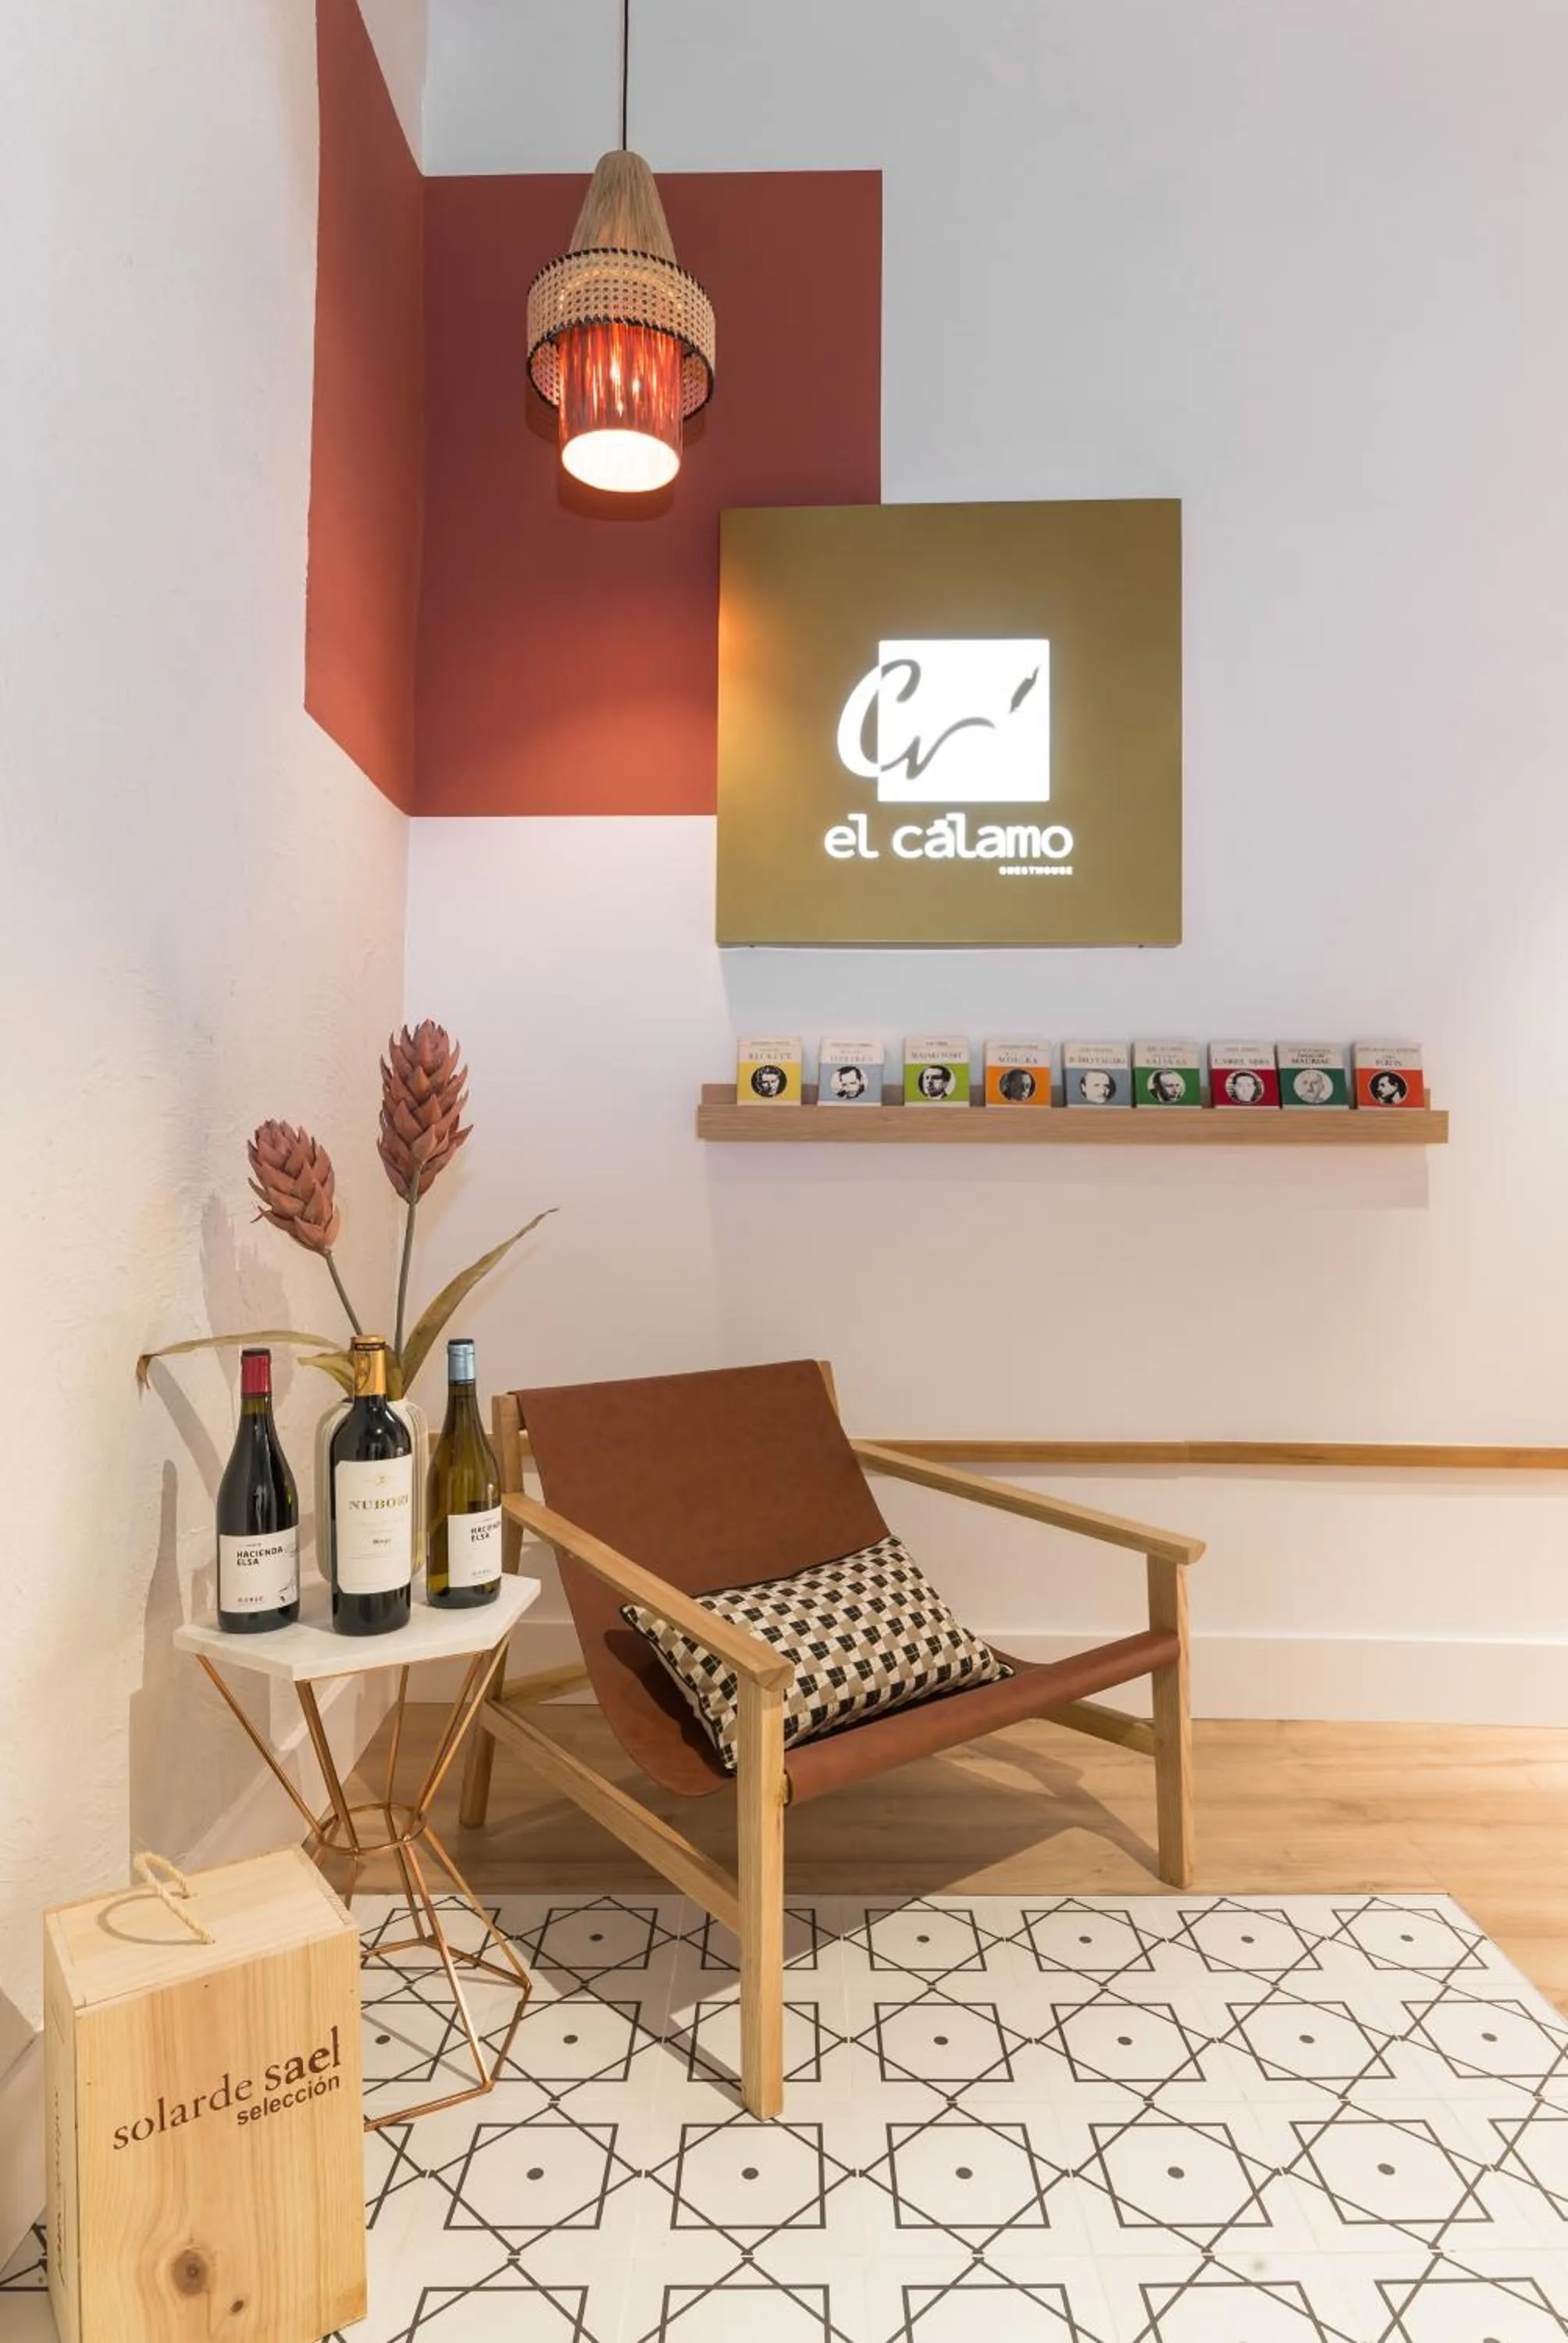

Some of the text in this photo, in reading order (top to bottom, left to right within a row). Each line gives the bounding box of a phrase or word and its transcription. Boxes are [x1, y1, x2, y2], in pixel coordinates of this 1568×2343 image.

[824, 812, 1074, 859] el cálamo
[999, 865, 1073, 876] GUESTHOUSE
[237, 1546, 283, 1558] HACIENDA
[237, 1558, 260, 1567] ELSA
[264, 2025, 341, 2092] sael
[236, 2074, 340, 2126] selección
